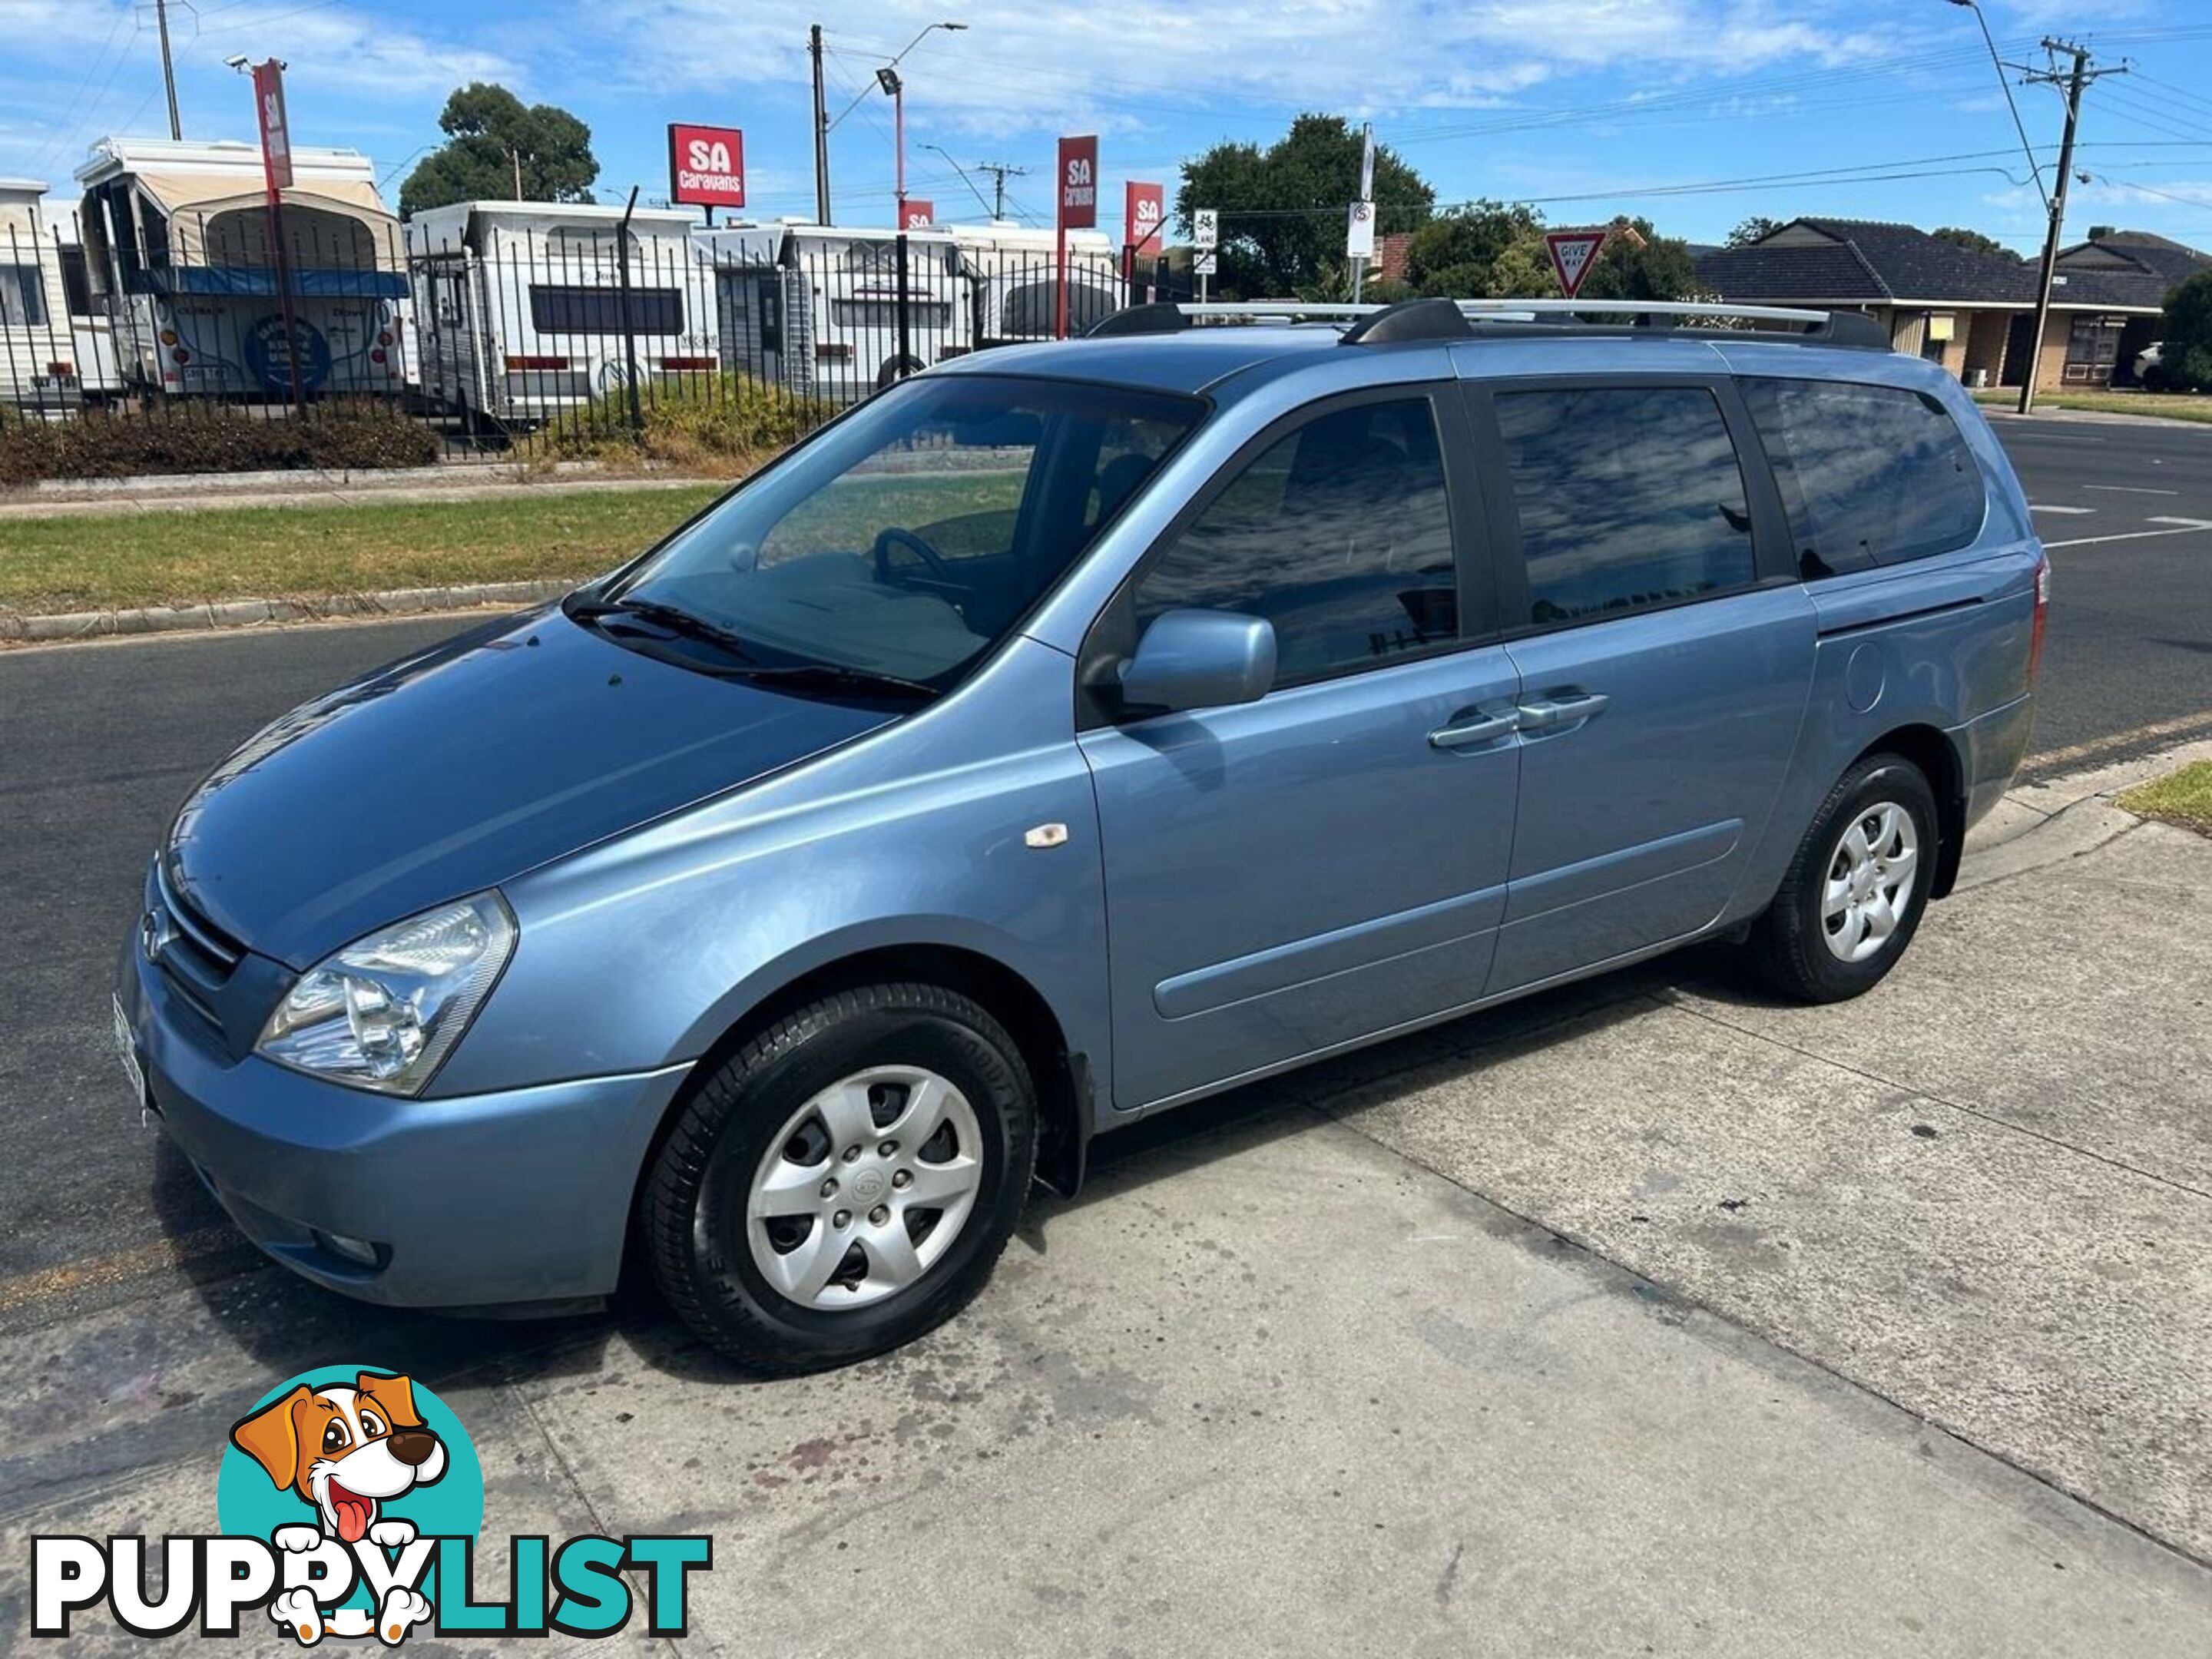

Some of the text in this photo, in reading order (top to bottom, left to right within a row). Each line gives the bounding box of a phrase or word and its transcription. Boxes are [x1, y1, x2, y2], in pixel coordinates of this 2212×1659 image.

[689, 139, 731, 174] SA
[679, 169, 740, 193] Caravans
[1068, 158, 1091, 185] SA
[909, 214, 929, 228] SA
[1137, 200, 1159, 221] SA
[1561, 245, 1587, 257] GIVE
[1565, 258, 1583, 267] WAY
